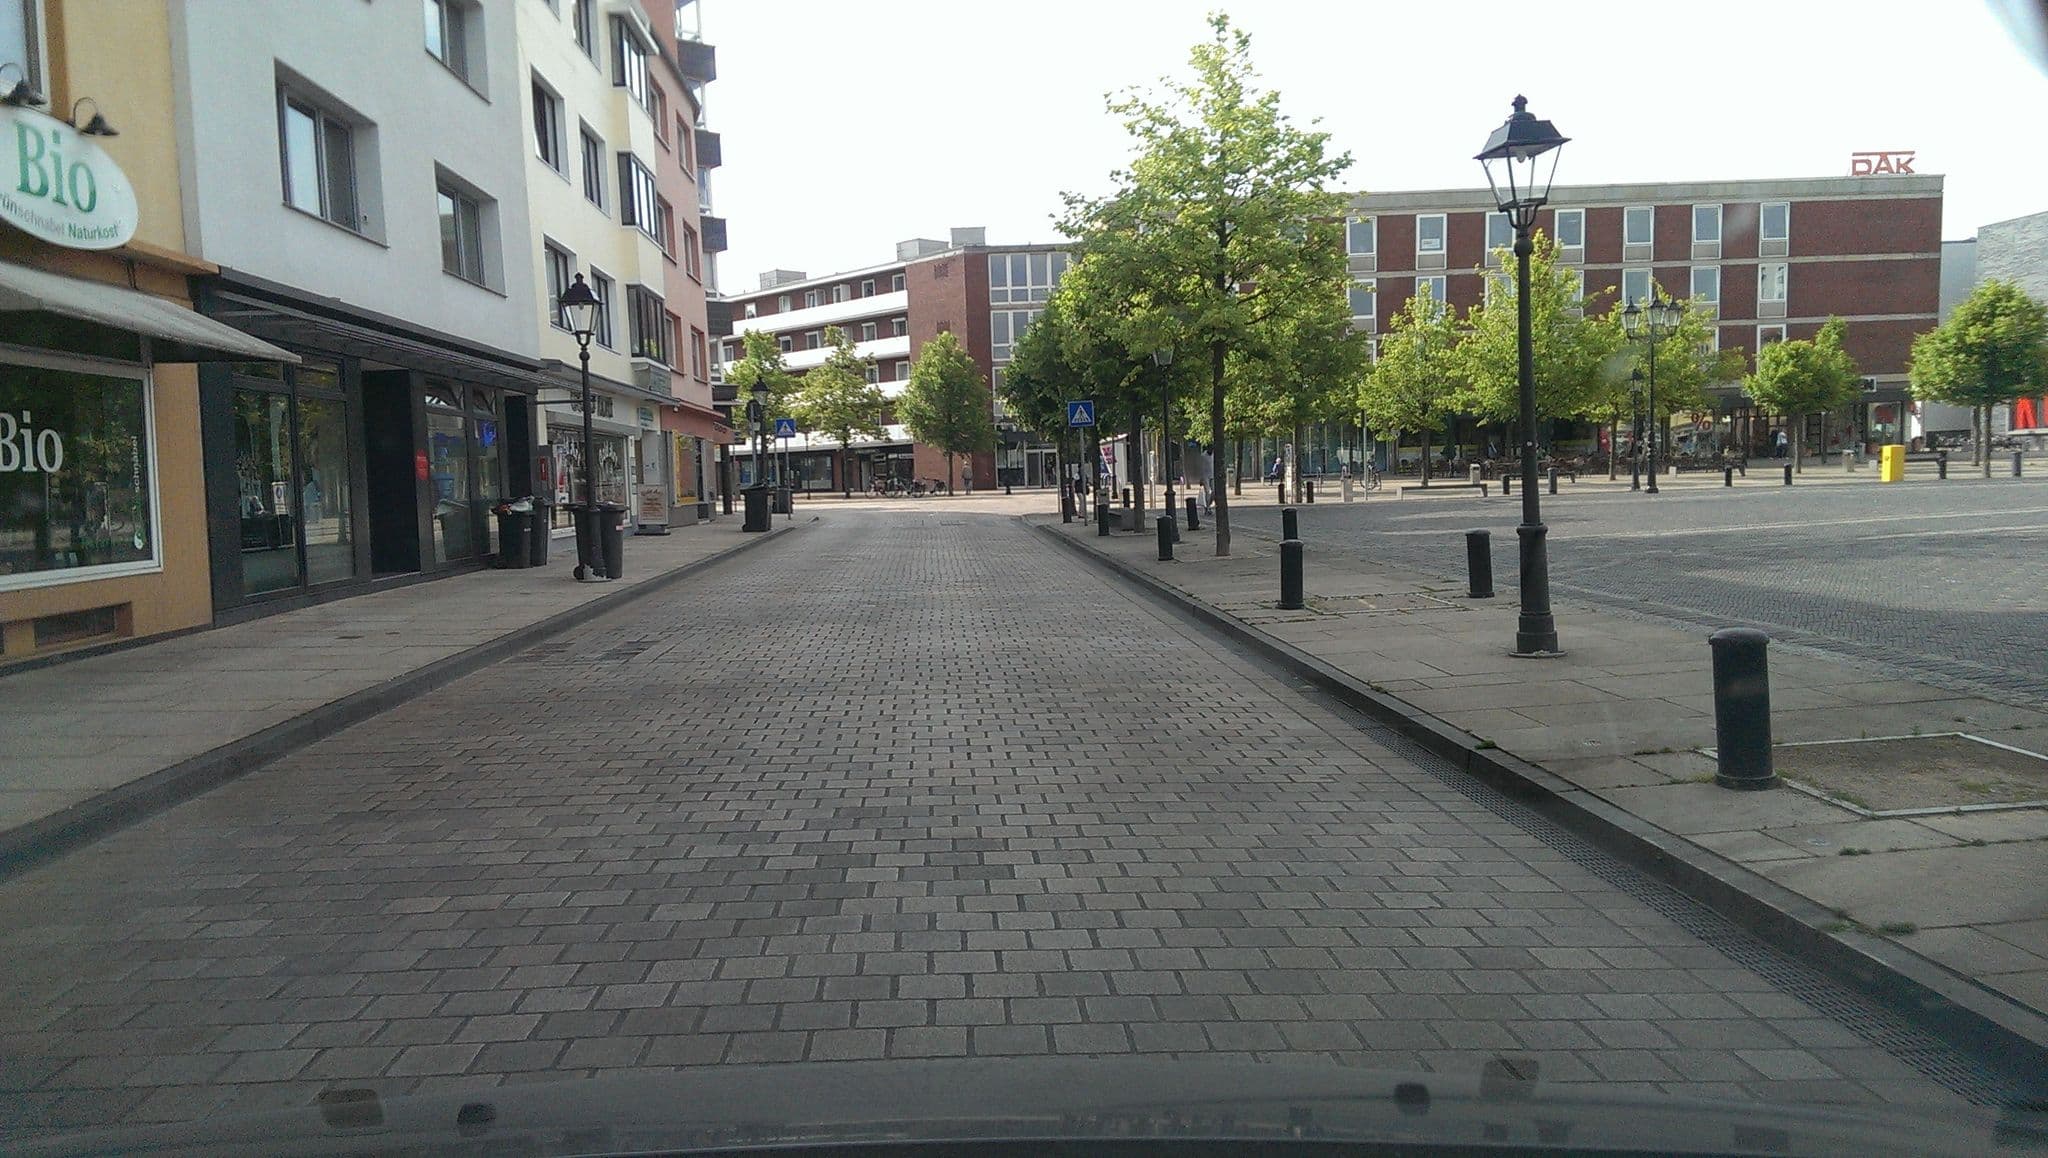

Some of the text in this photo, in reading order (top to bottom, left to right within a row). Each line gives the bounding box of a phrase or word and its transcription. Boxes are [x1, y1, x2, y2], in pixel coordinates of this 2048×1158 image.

[15, 120, 97, 213] Bio
[1851, 151, 1915, 176] DAK
[68, 222, 119, 240] Naturkost
[0, 410, 64, 473] Bio
